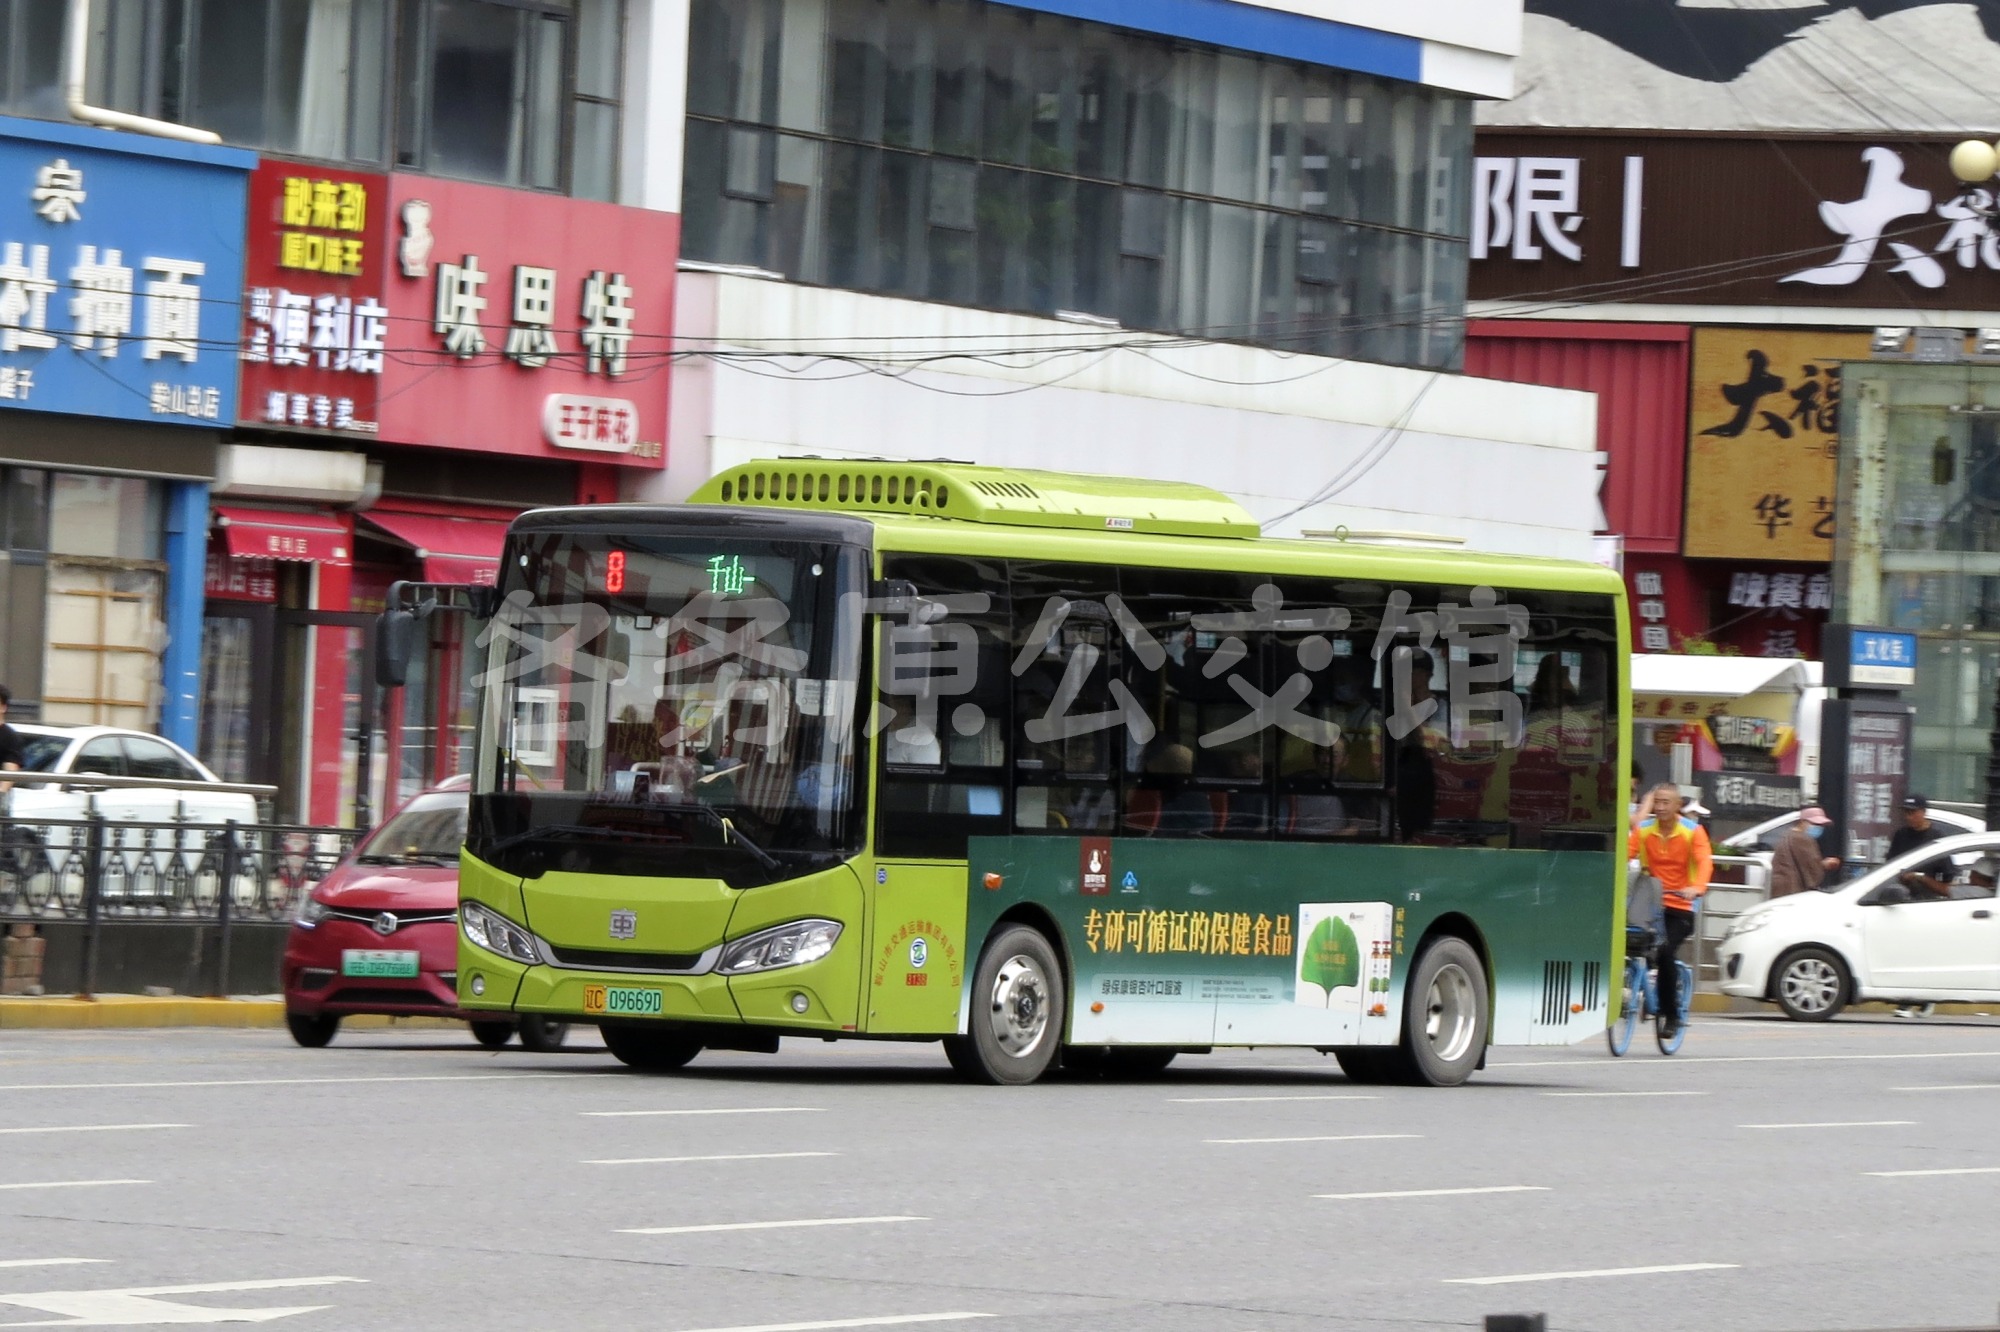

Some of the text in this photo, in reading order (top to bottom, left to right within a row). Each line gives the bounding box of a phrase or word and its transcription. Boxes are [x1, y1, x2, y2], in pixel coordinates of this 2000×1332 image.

[272, 288, 389, 374] 便利店
[434, 254, 635, 377] 味思特
[558, 404, 631, 445] 王子麻花
[1083, 908, 1293, 957] 专研可循证的保健食品
